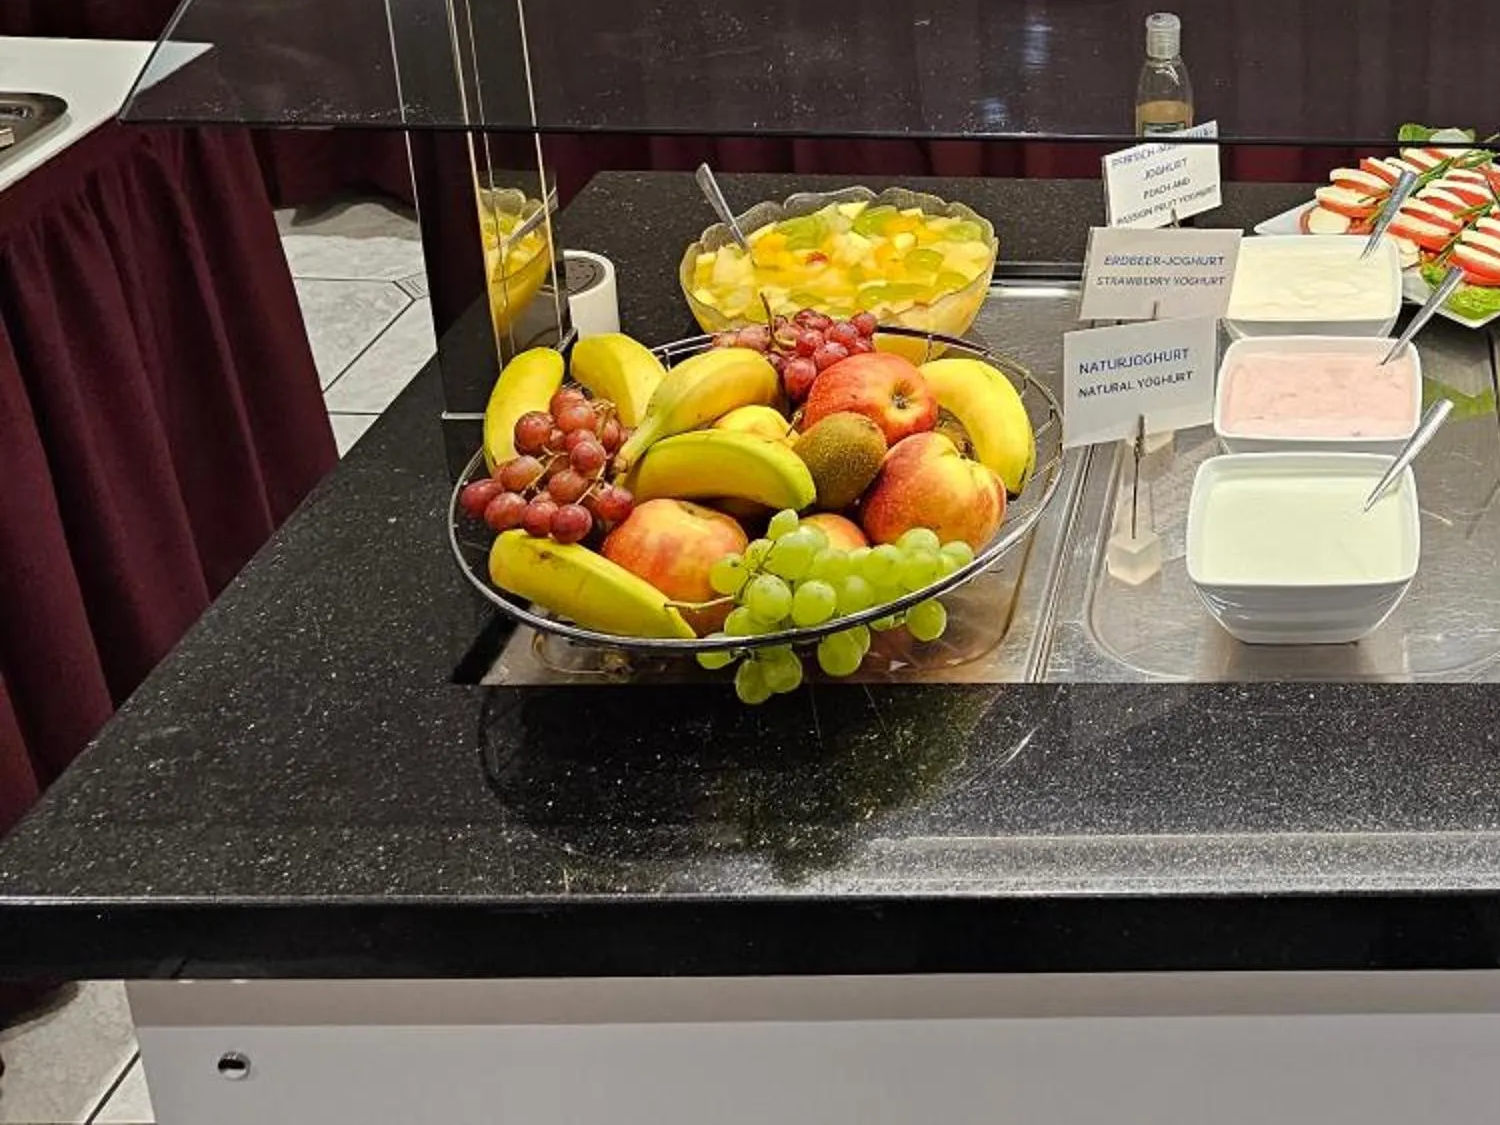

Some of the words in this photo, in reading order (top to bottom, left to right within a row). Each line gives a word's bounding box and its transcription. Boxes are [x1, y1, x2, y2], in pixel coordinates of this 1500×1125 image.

[1143, 156, 1188, 180] JOGHURT
[1103, 253, 1226, 267] ERDBEER-JOGHURT
[1096, 275, 1171, 287] STRAWBERRY
[1173, 275, 1227, 287] YOGHURT
[1079, 347, 1190, 376] NATURJOGHURT
[1077, 379, 1134, 399] NATURAL
[1136, 369, 1195, 390] YOGHURT
